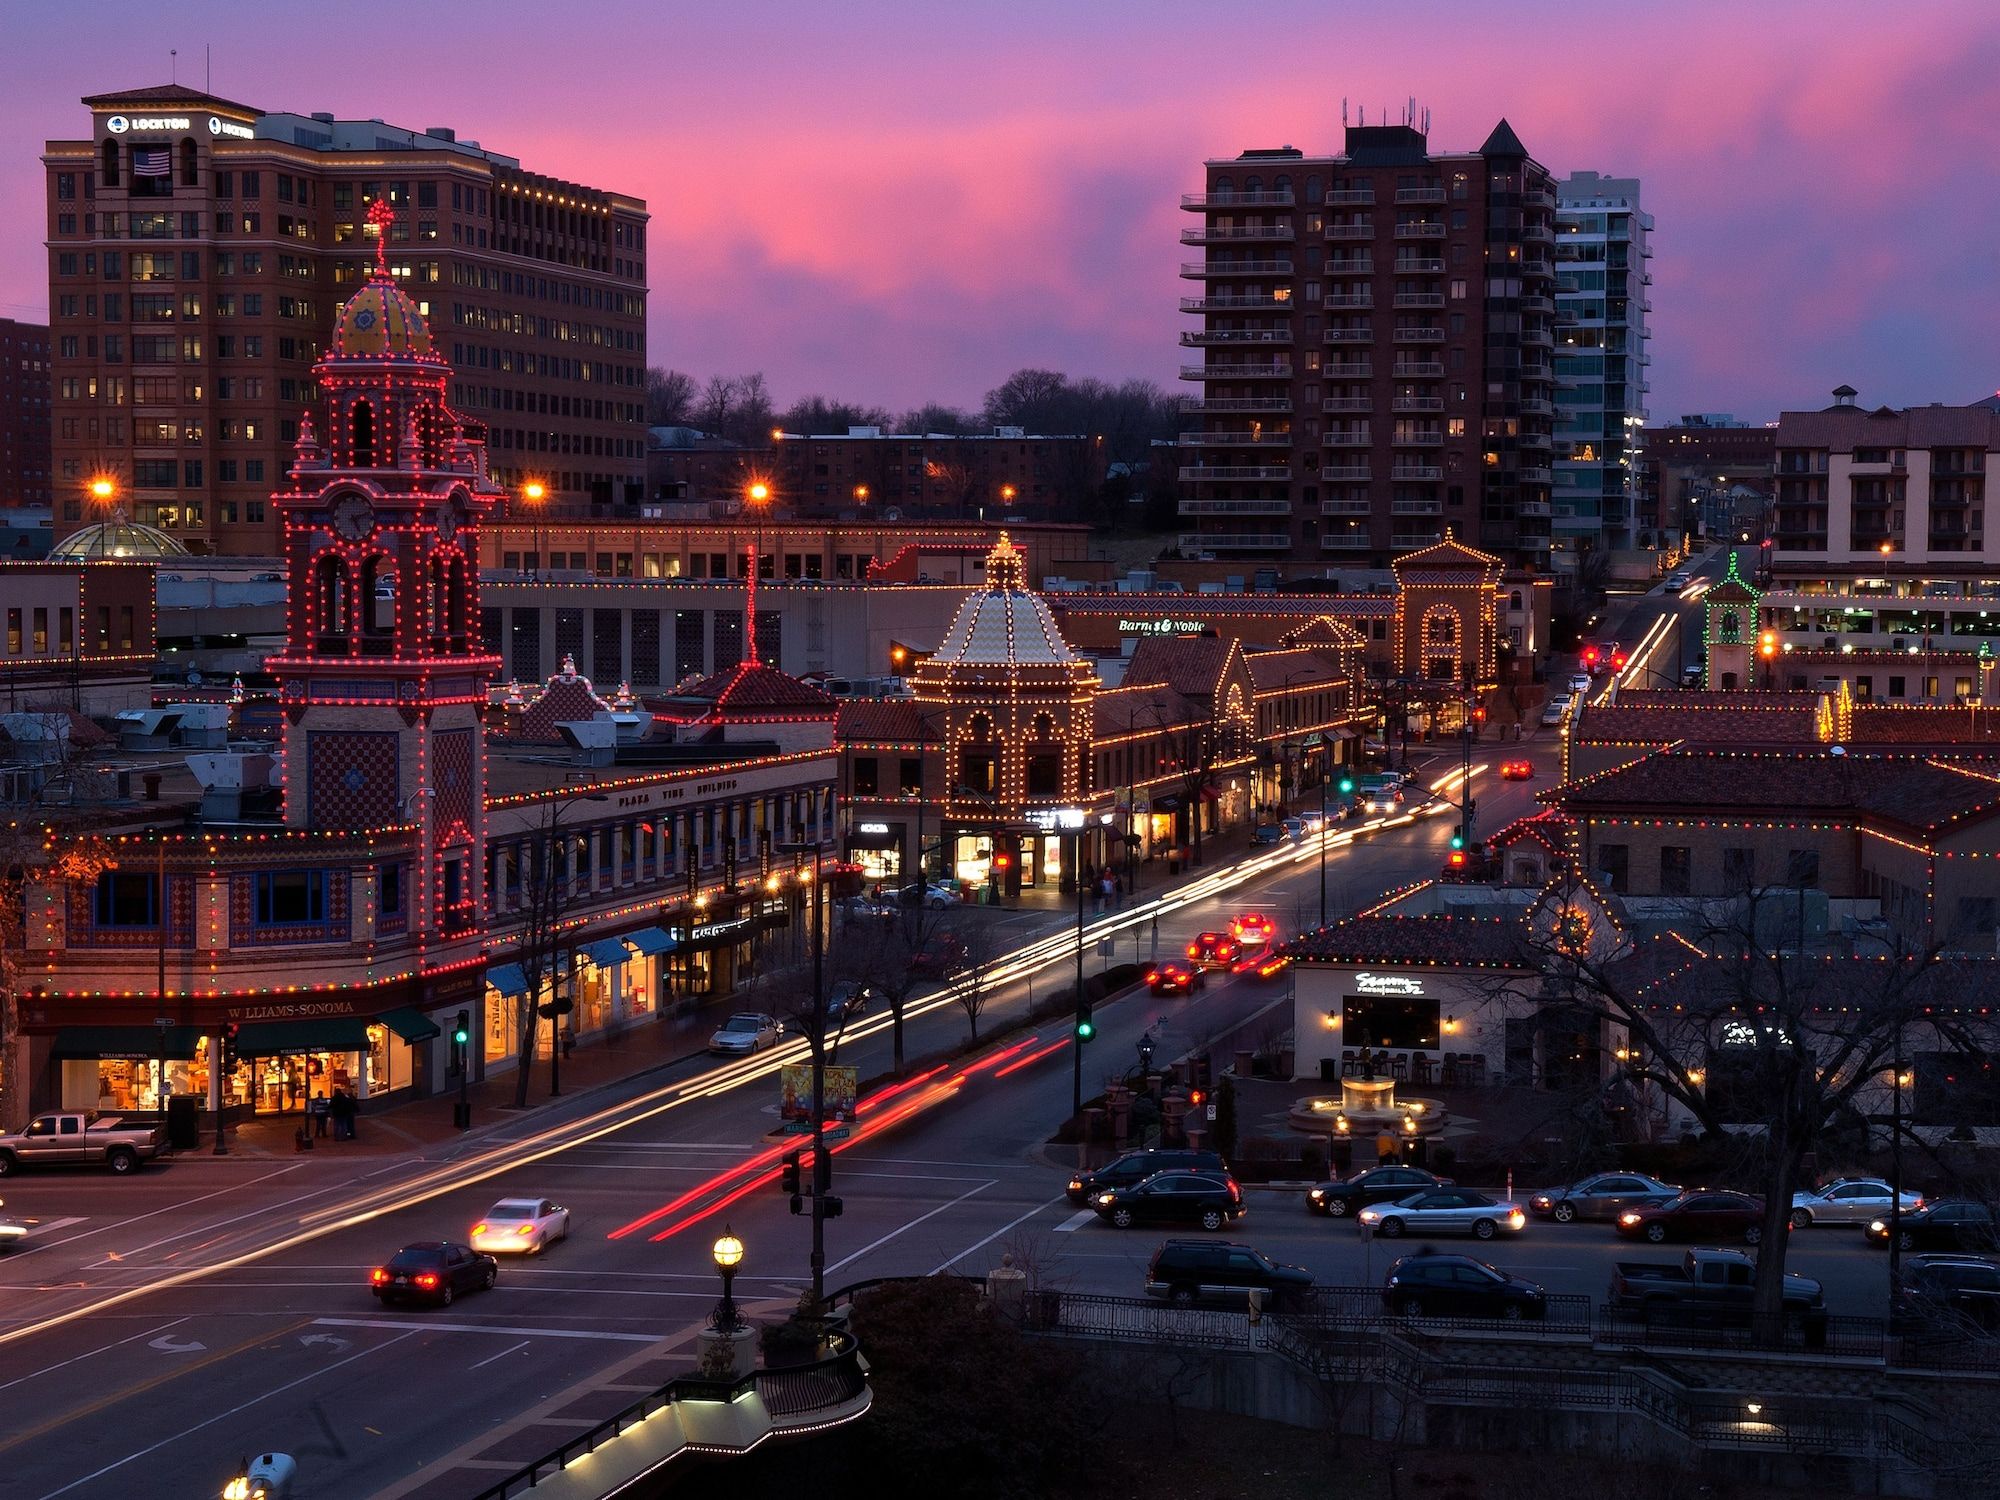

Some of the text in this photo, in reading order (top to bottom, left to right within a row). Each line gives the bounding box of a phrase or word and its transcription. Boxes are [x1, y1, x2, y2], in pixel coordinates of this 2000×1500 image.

[132, 118, 190, 131] LOCKTON
[619, 779, 738, 807] PLAZA TIME BUILDING
[228, 1002, 354, 1018] WLLIAMS-SONOMA
